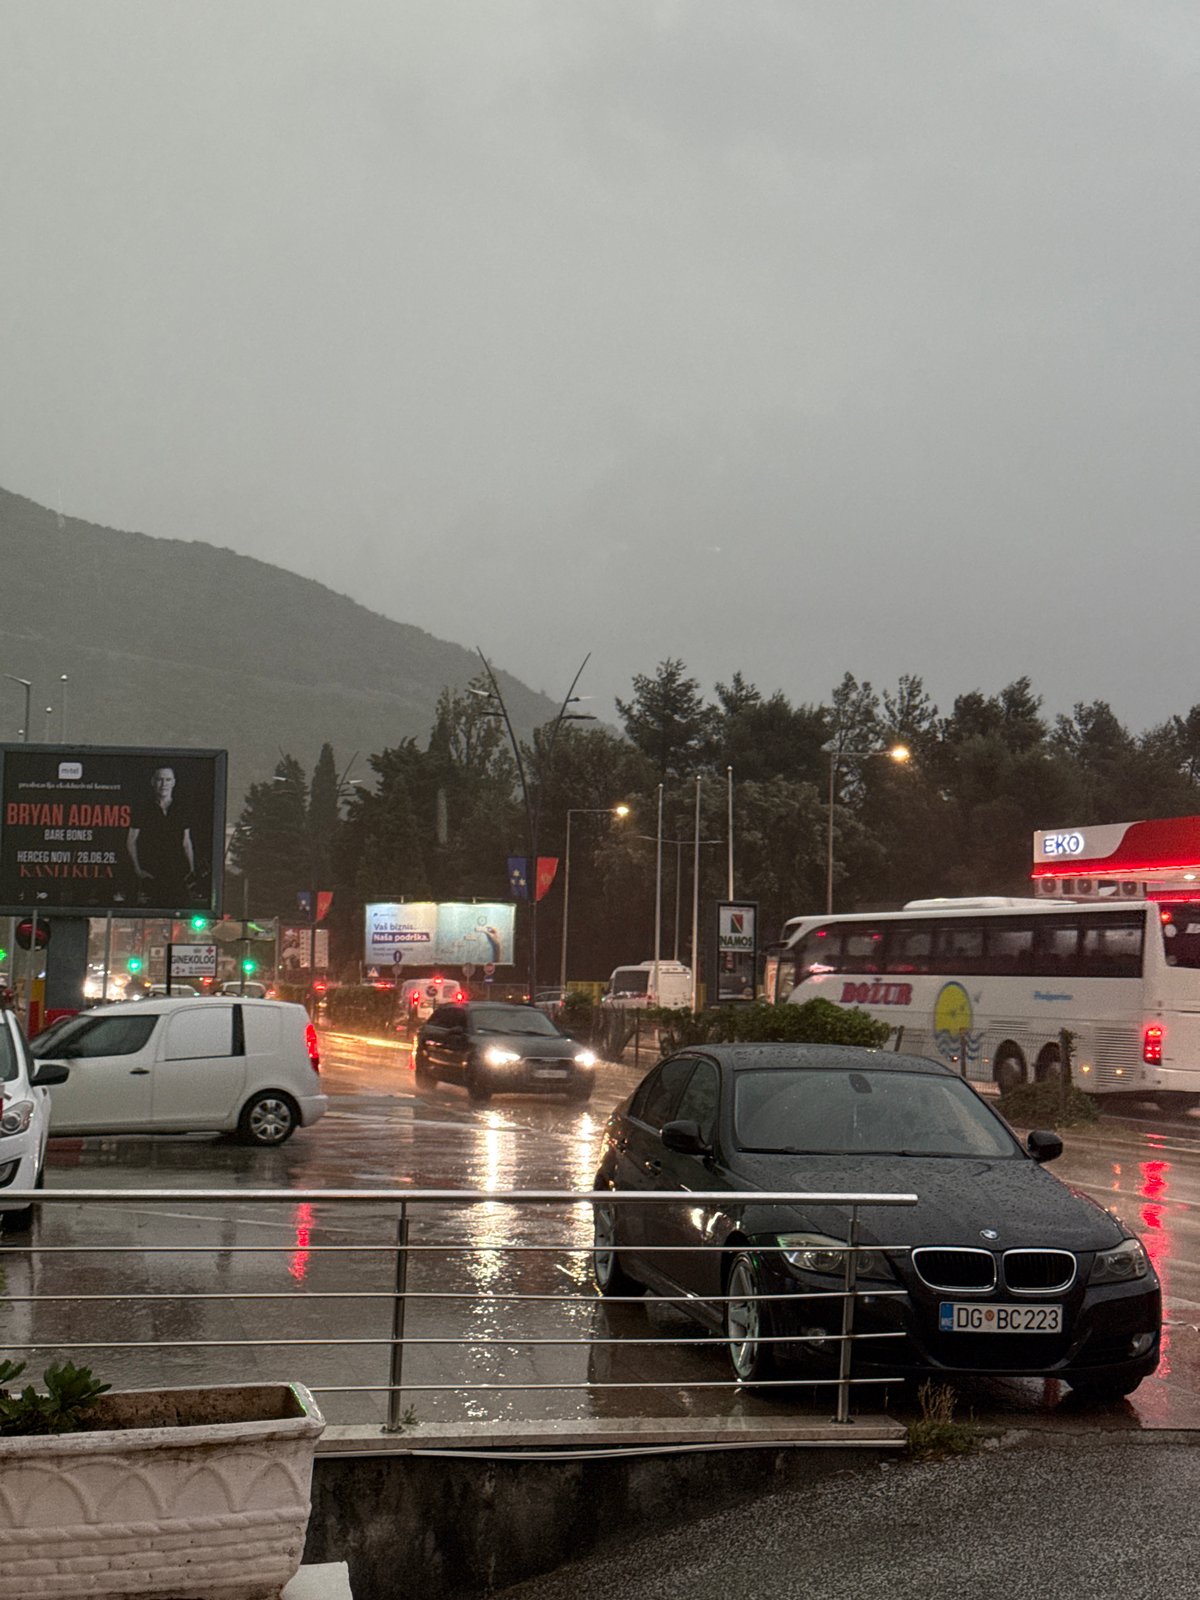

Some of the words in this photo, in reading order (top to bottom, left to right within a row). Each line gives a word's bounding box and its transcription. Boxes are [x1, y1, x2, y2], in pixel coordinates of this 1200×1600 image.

[6, 803, 64, 826] BRYAN
[68, 804, 131, 827] ADAMS
[44, 830, 65, 841] BARE
[66, 830, 93, 841] BONES
[1043, 835, 1080, 854] EKO
[17, 851, 49, 863] HERCEG
[51, 852, 71, 863] NOVI
[373, 933, 393, 942] Naša
[171, 955, 215, 965] GINEKOLOG
[957, 1308, 982, 1328] DG
[997, 1309, 1059, 1330] BC223
